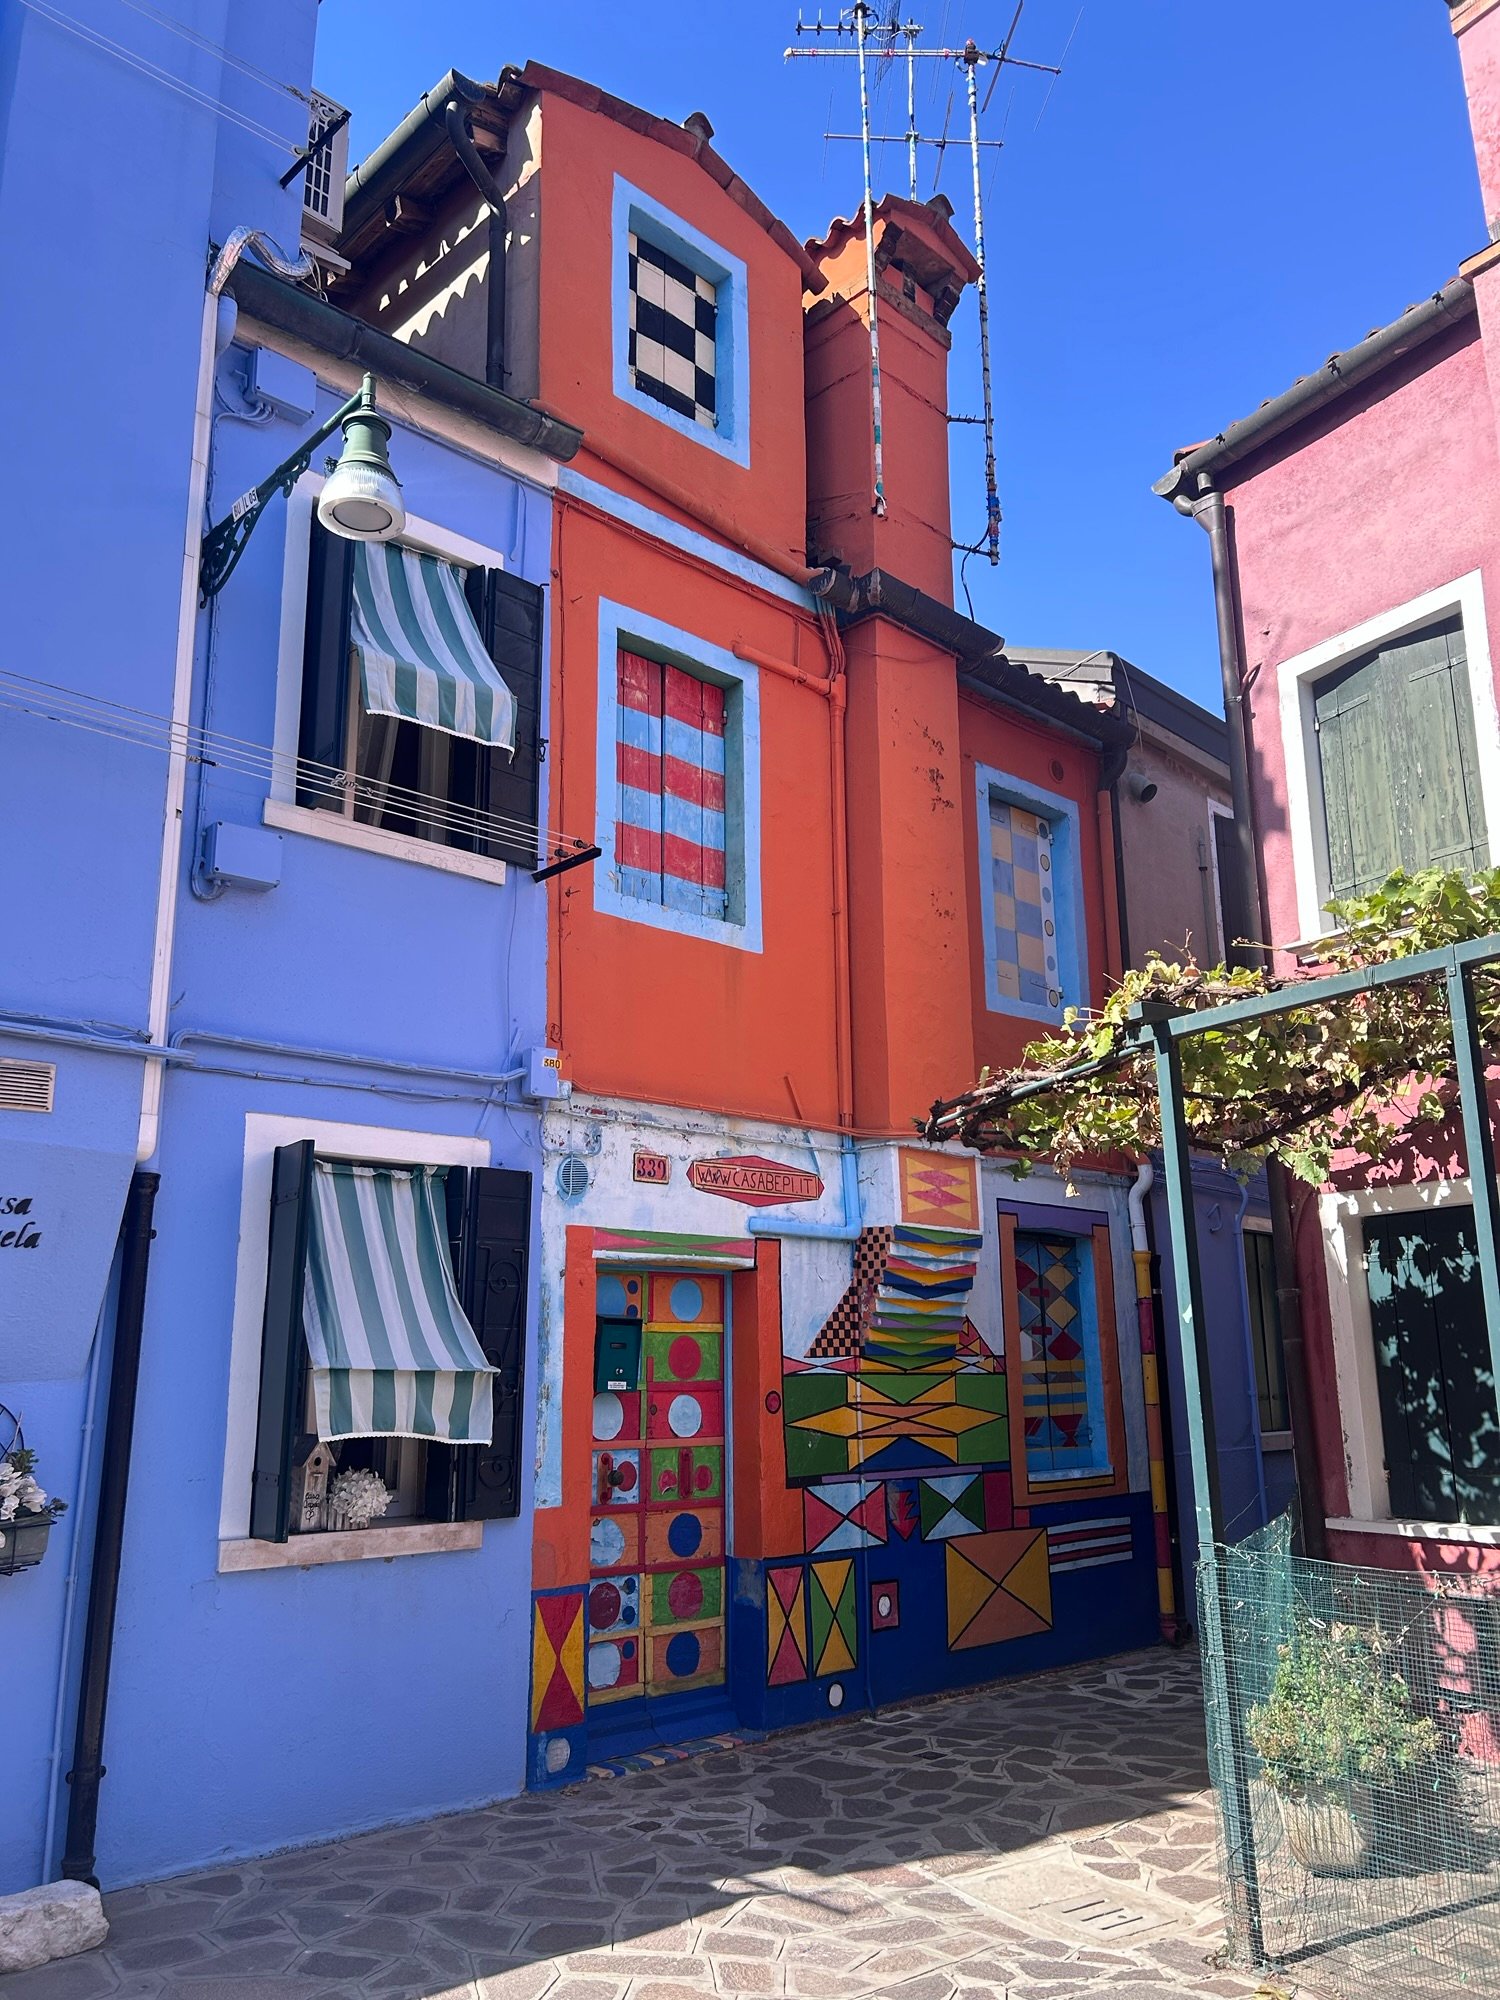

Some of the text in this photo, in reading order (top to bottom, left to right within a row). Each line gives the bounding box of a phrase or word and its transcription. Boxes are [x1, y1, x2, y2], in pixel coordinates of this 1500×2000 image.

[637, 1158, 666, 1180] 339
[0, 1197, 33, 1215] sa
[0, 1221, 42, 1249] ela
